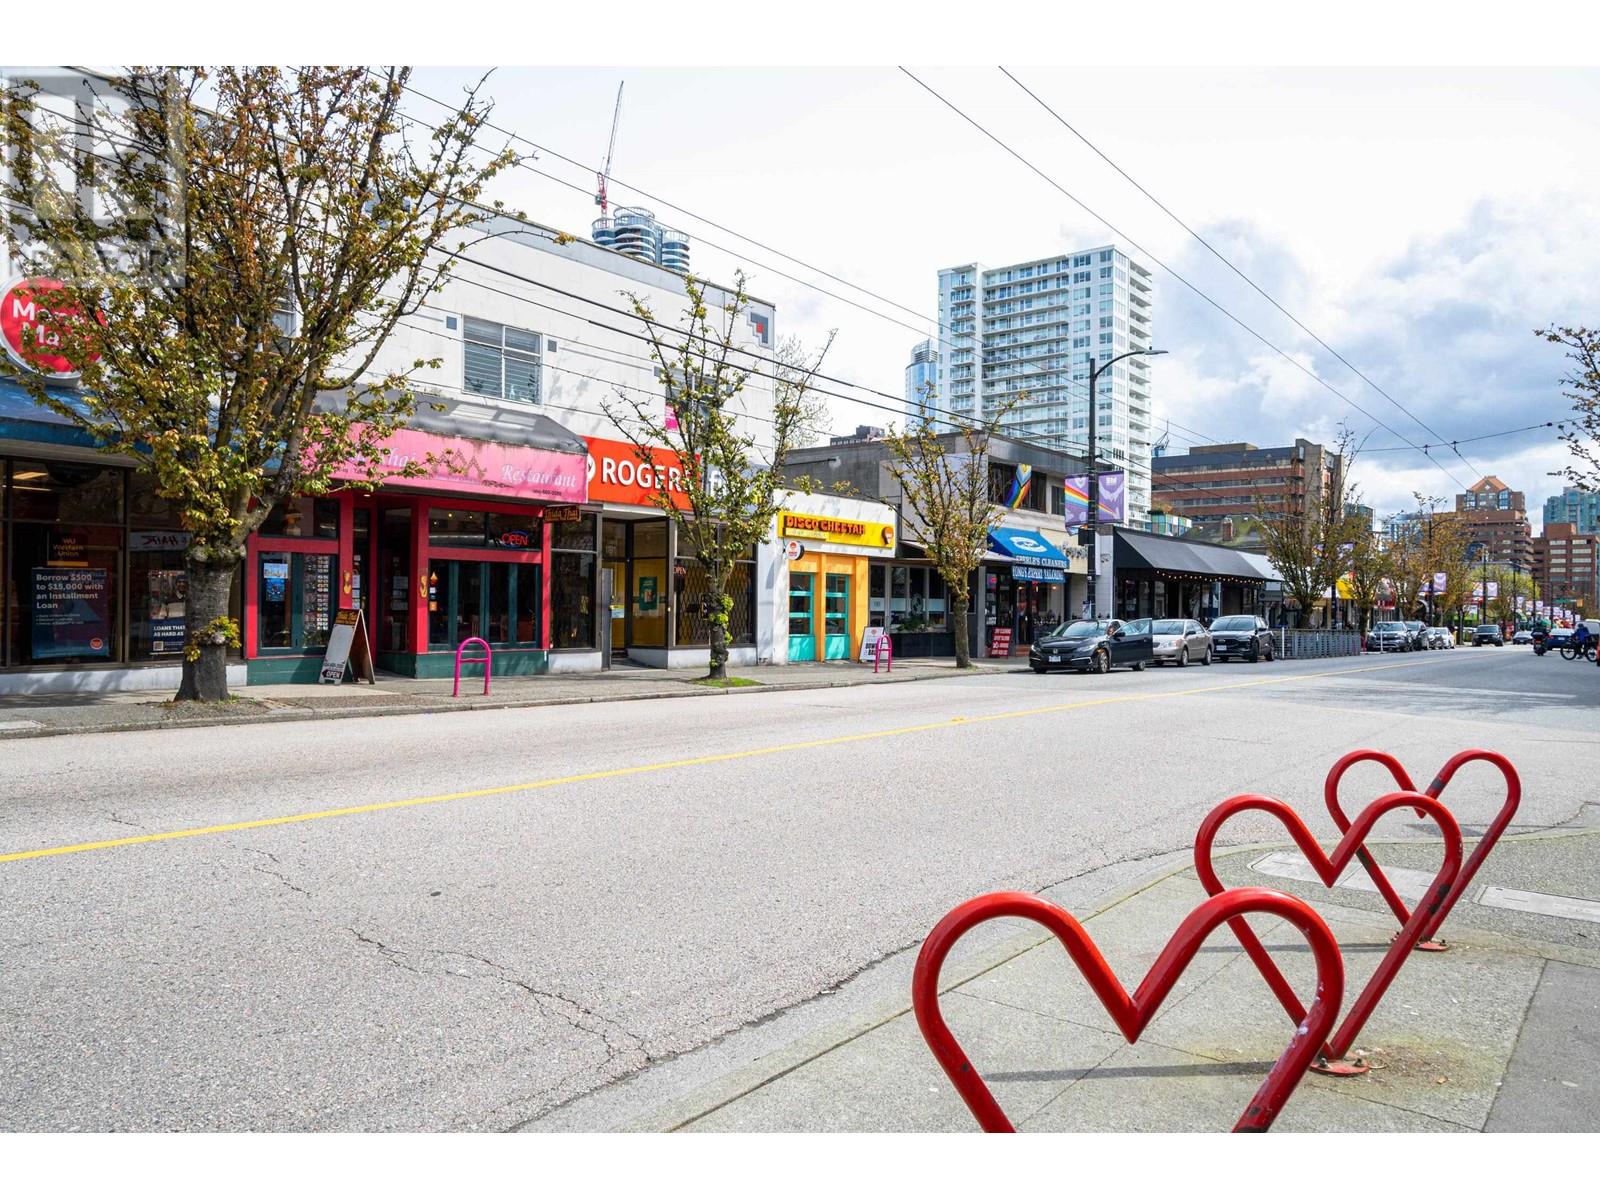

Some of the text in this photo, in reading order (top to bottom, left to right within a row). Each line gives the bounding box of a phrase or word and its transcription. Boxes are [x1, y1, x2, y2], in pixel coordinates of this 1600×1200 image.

[502, 464, 577, 488] Restaurant
[785, 515, 819, 530] DISCO
[820, 520, 866, 535] CHEETAH
[501, 533, 529, 546] OPEN
[70, 573, 92, 581] $500
[47, 582, 83, 592] $15,000
[49, 592, 99, 600] Installment
[325, 671, 341, 679] OPEN
